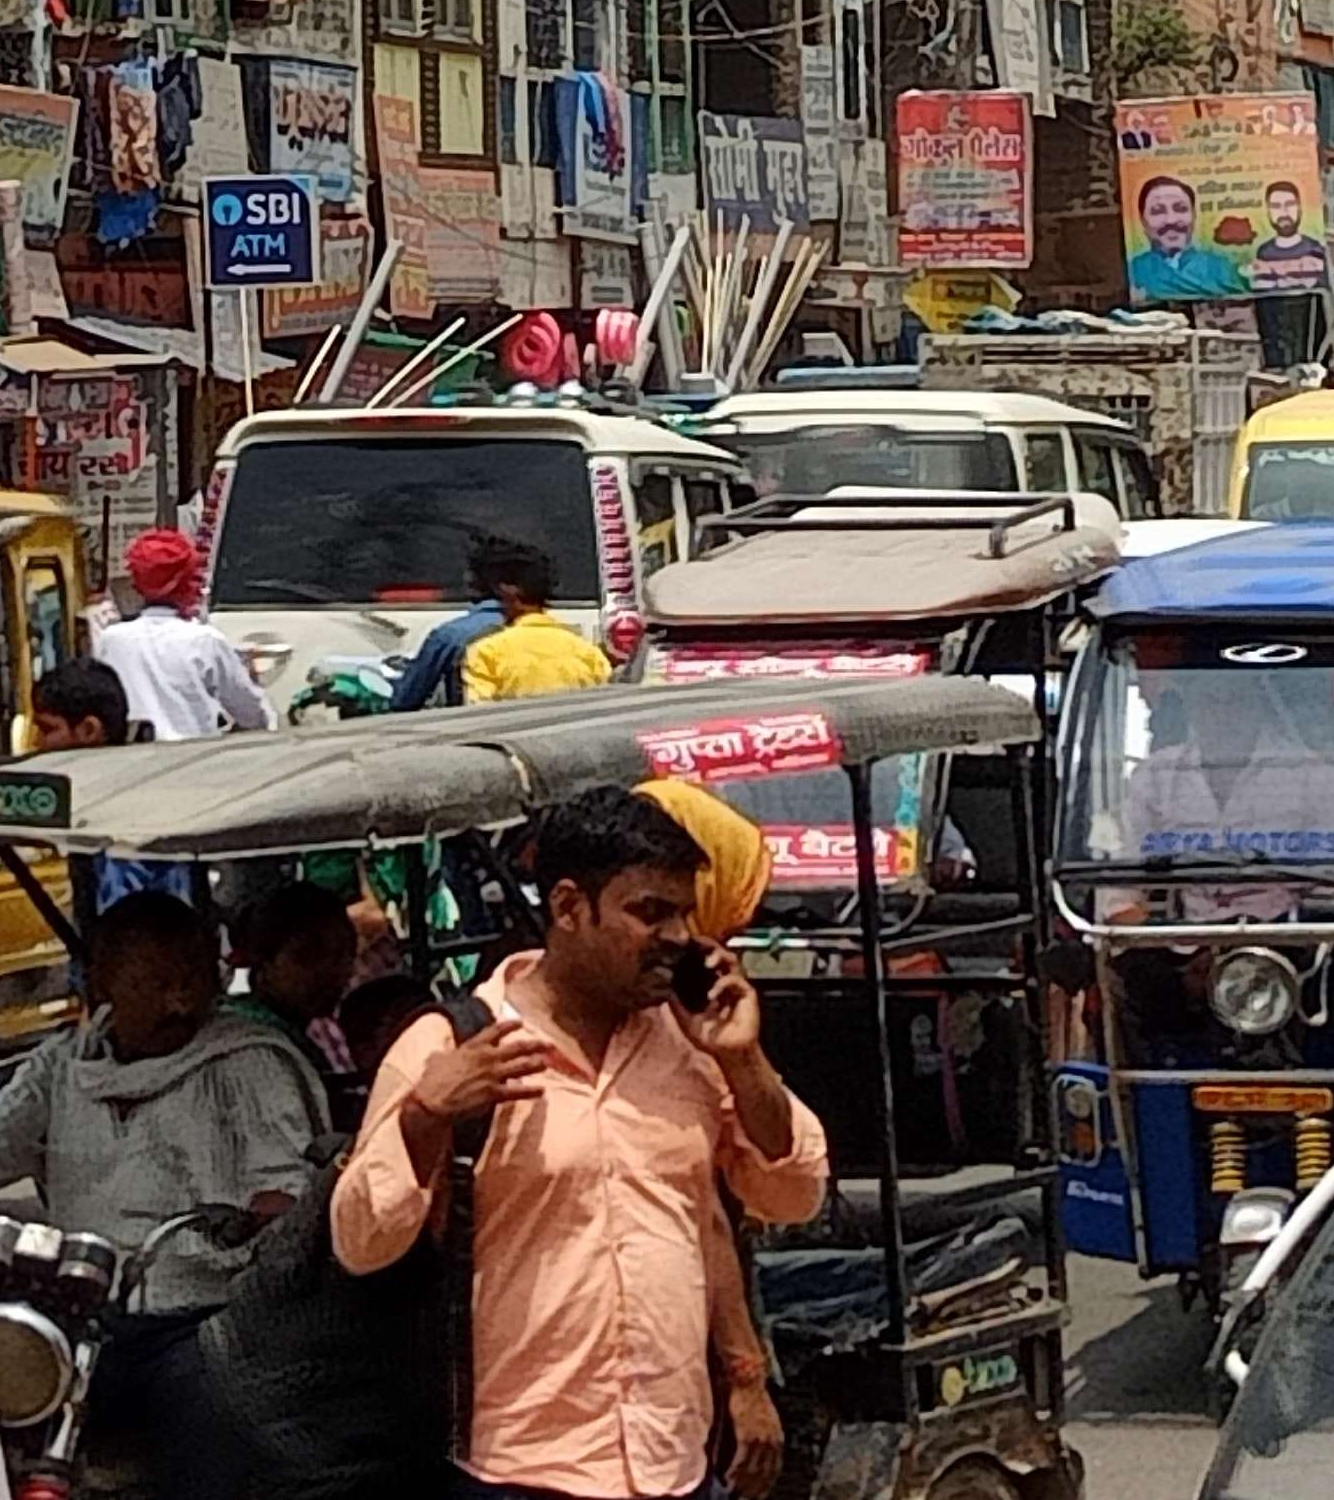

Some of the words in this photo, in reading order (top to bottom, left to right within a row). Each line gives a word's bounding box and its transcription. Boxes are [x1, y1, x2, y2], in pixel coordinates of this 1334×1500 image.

[245, 192, 302, 226] SBI
[230, 233, 286, 258] ATM
[645, 732, 745, 771] गुप्ता
[799, 828, 892, 858] बैटी
